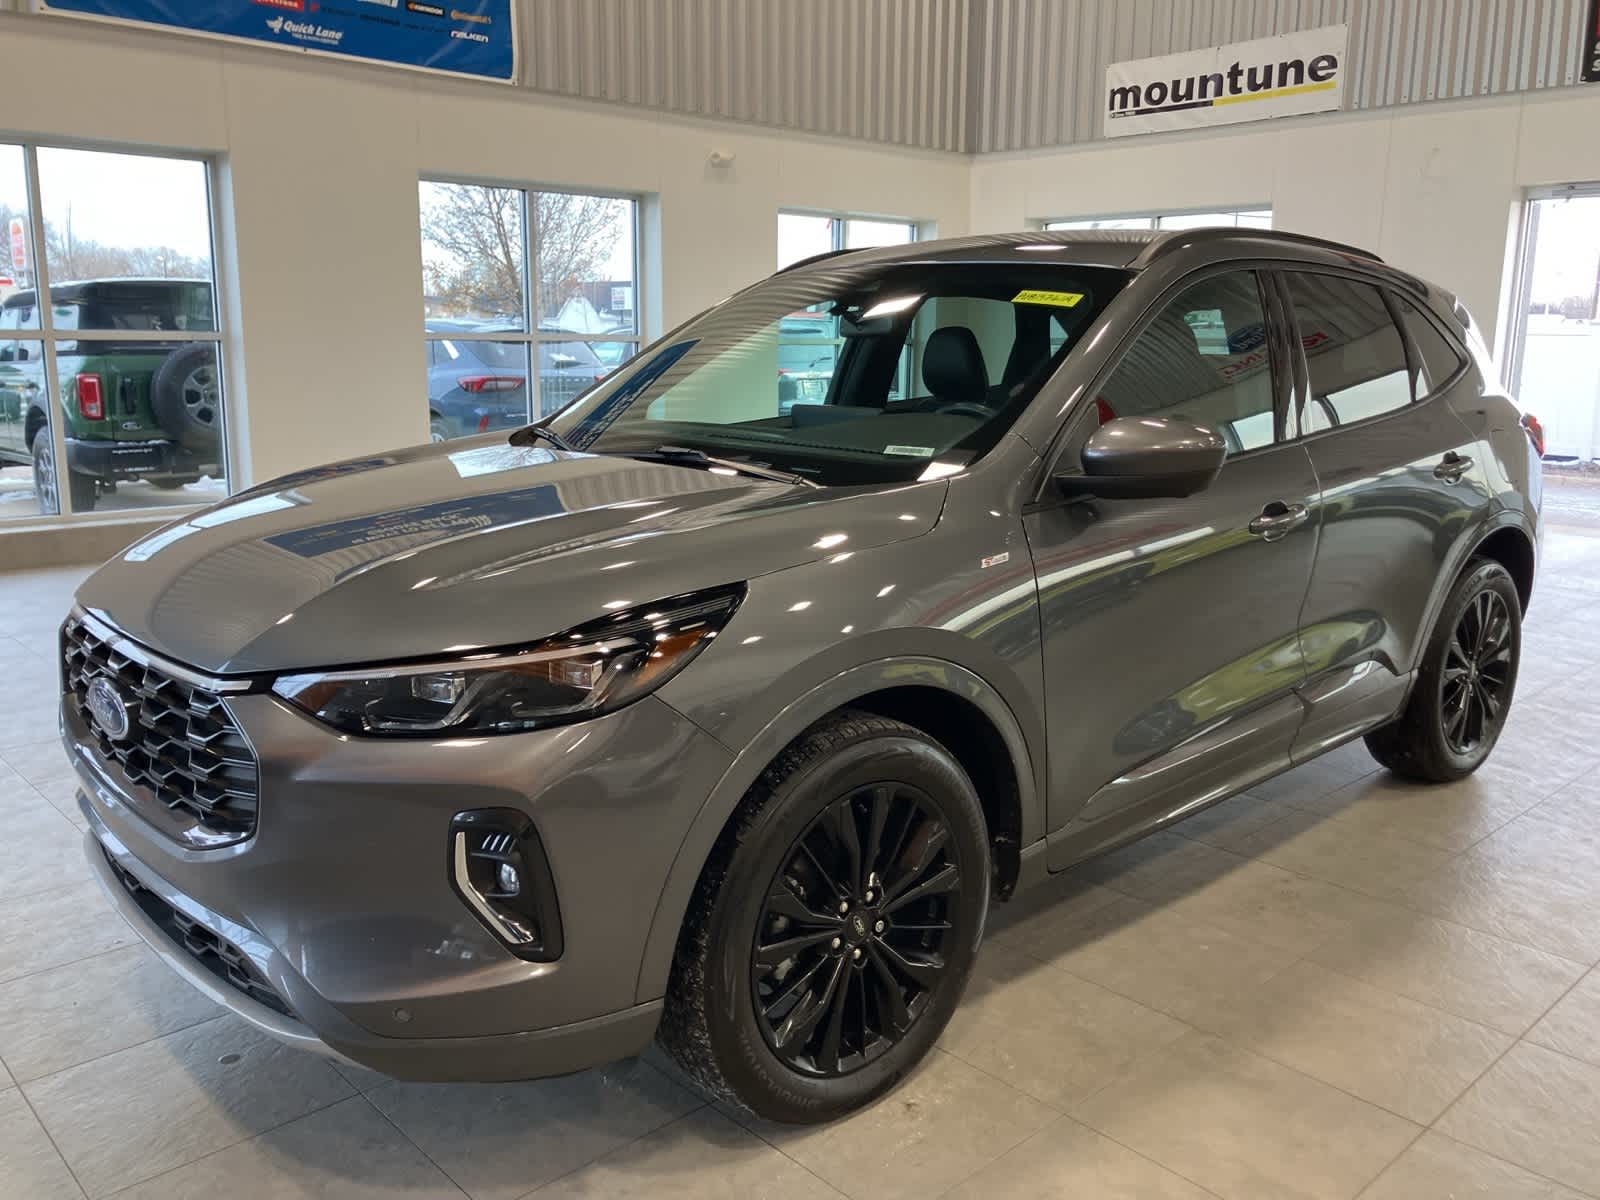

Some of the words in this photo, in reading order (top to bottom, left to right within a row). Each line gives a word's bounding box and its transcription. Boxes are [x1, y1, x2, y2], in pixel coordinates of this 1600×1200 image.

[283, 20, 315, 34] Quick
[315, 25, 343, 39] Lane
[1109, 54, 1339, 111] mountune
